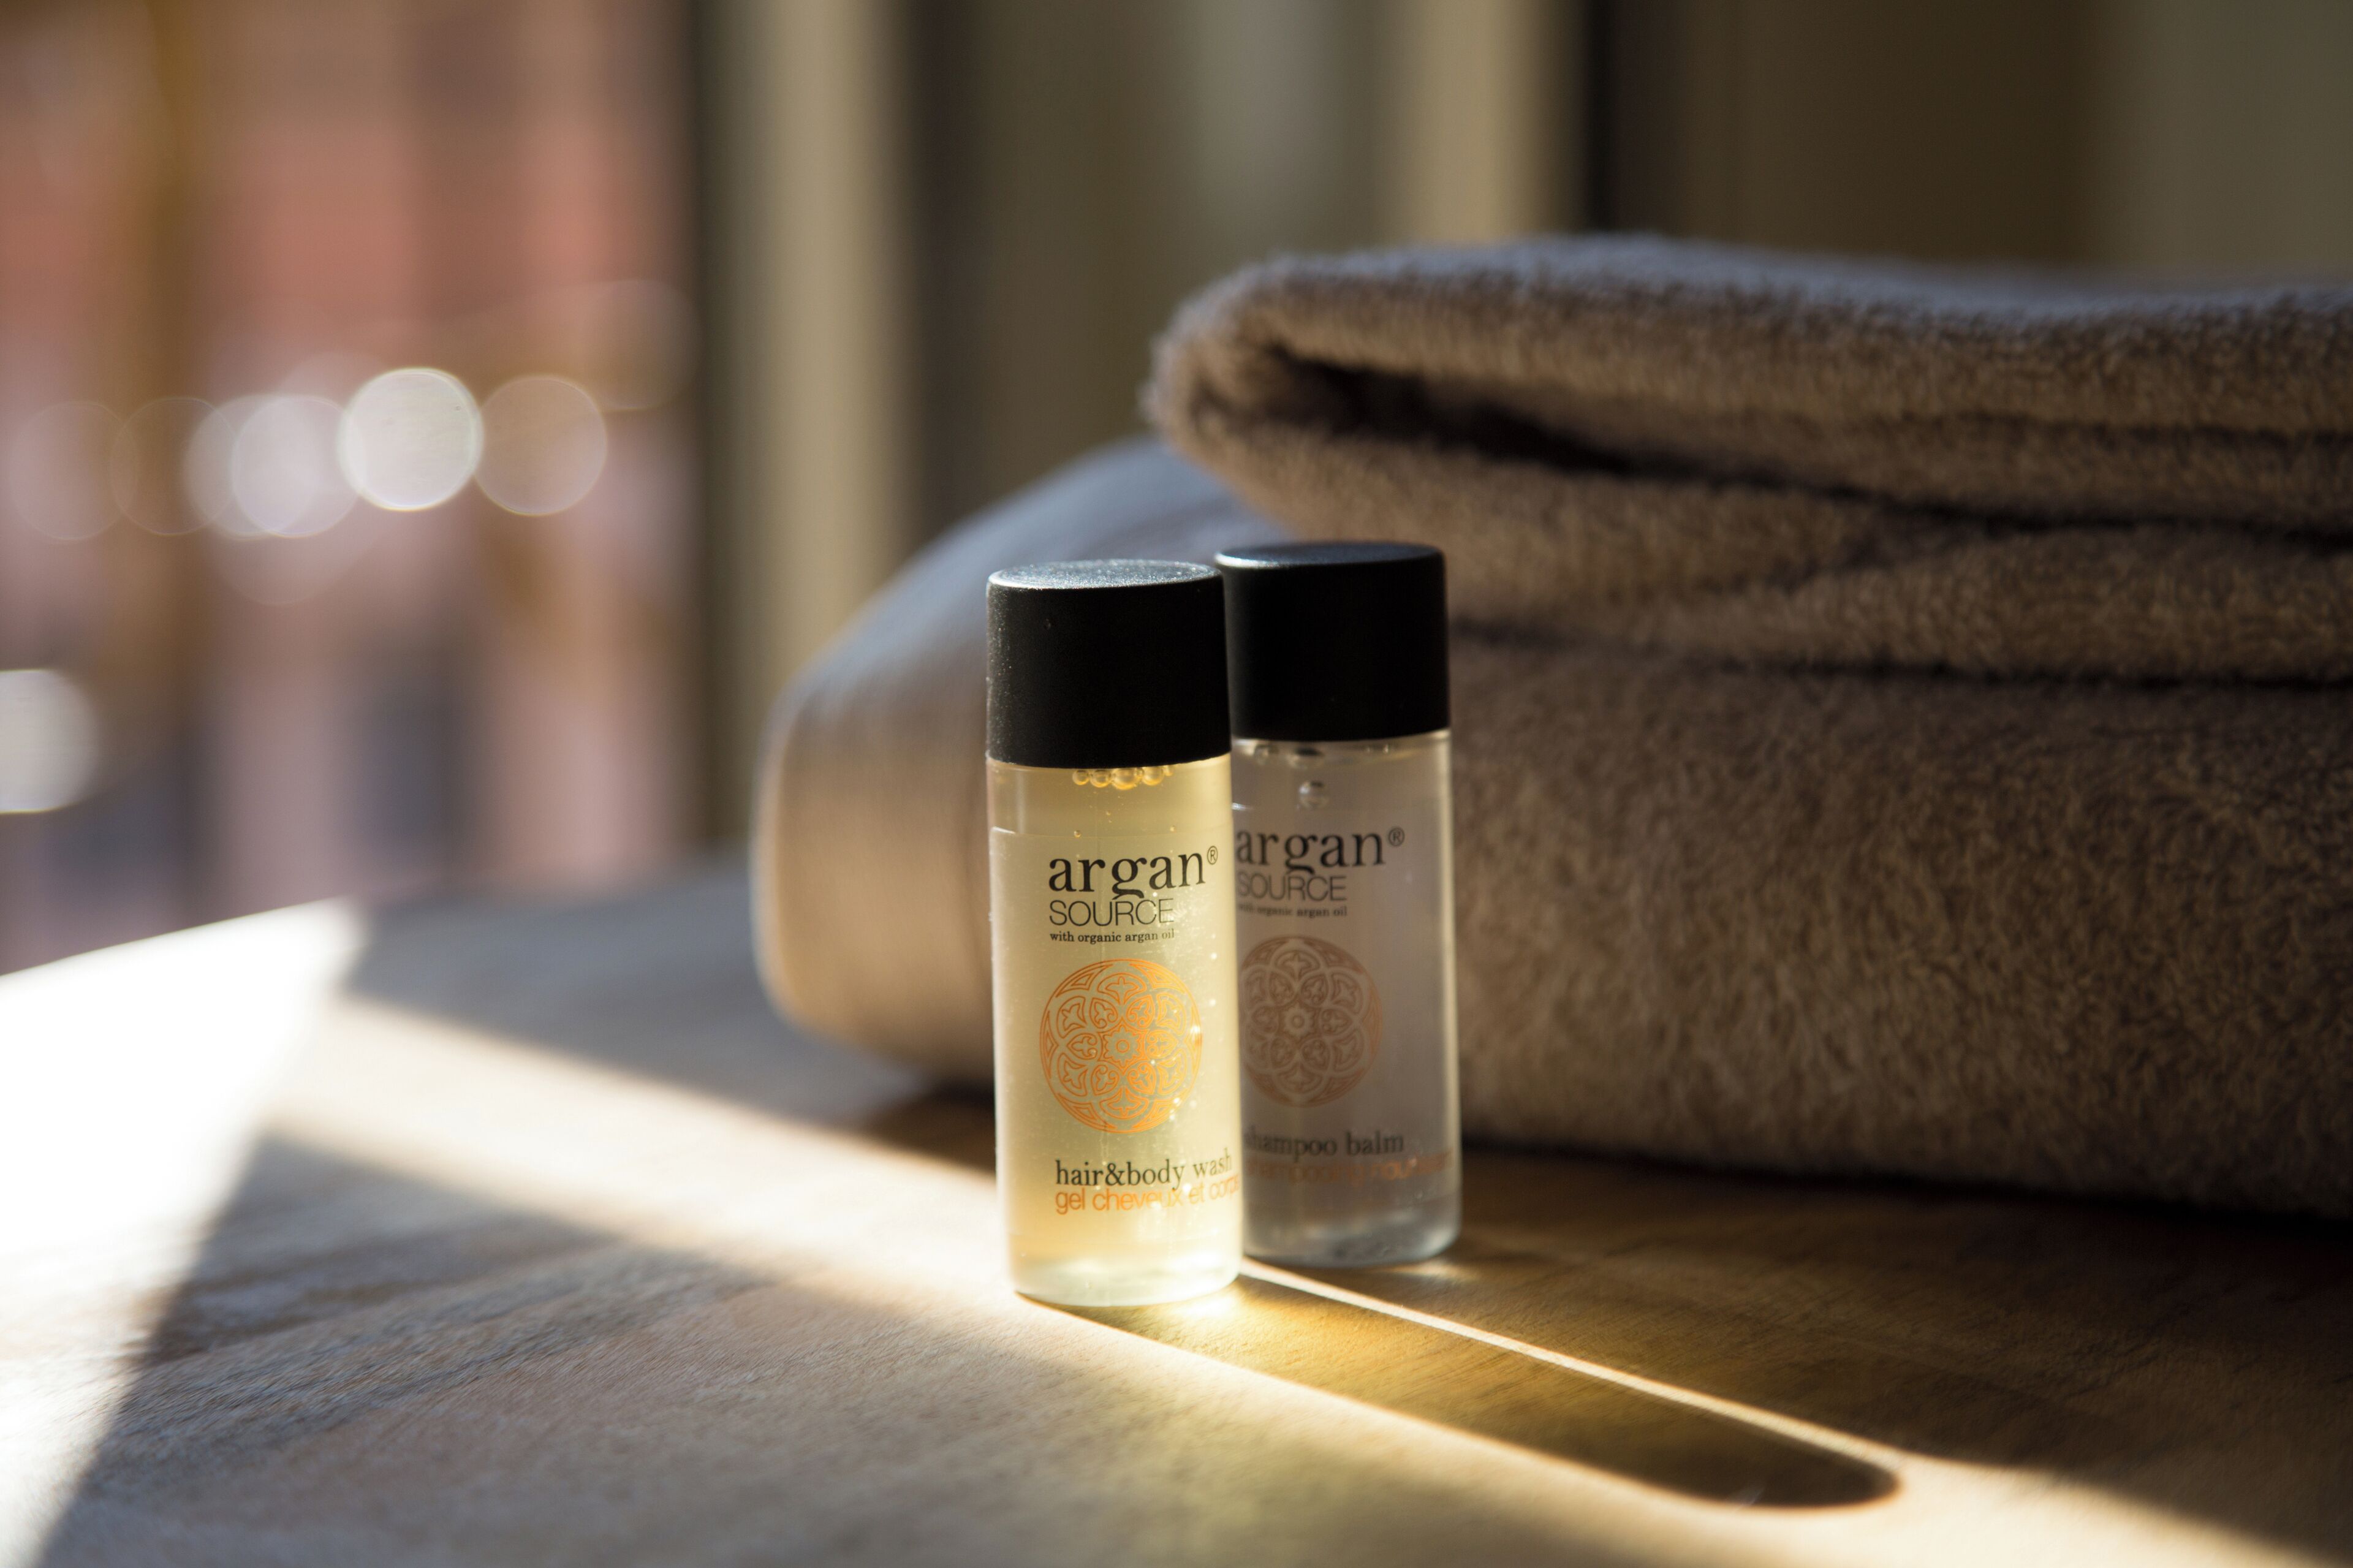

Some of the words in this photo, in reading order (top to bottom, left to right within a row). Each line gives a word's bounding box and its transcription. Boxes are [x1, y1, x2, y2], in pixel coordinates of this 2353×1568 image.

[1237, 870, 1348, 902] SOURCE
[1049, 898, 1175, 926] SOURCE
[1296, 907, 1330, 918] argan
[1333, 905, 1347, 917] oil
[1049, 931, 1075, 942] with
[1077, 931, 1121, 944] organic
[1125, 931, 1159, 944] argan
[1162, 928, 1175, 940] oil
[1345, 1130, 1404, 1156] balm
[1055, 1158, 1185, 1192] hair&body
[1192, 1146, 1232, 1179] wash
[1055, 1187, 1086, 1215] gel
[1092, 1187, 1183, 1211] cheveux
[1188, 1181, 1205, 1205] et
